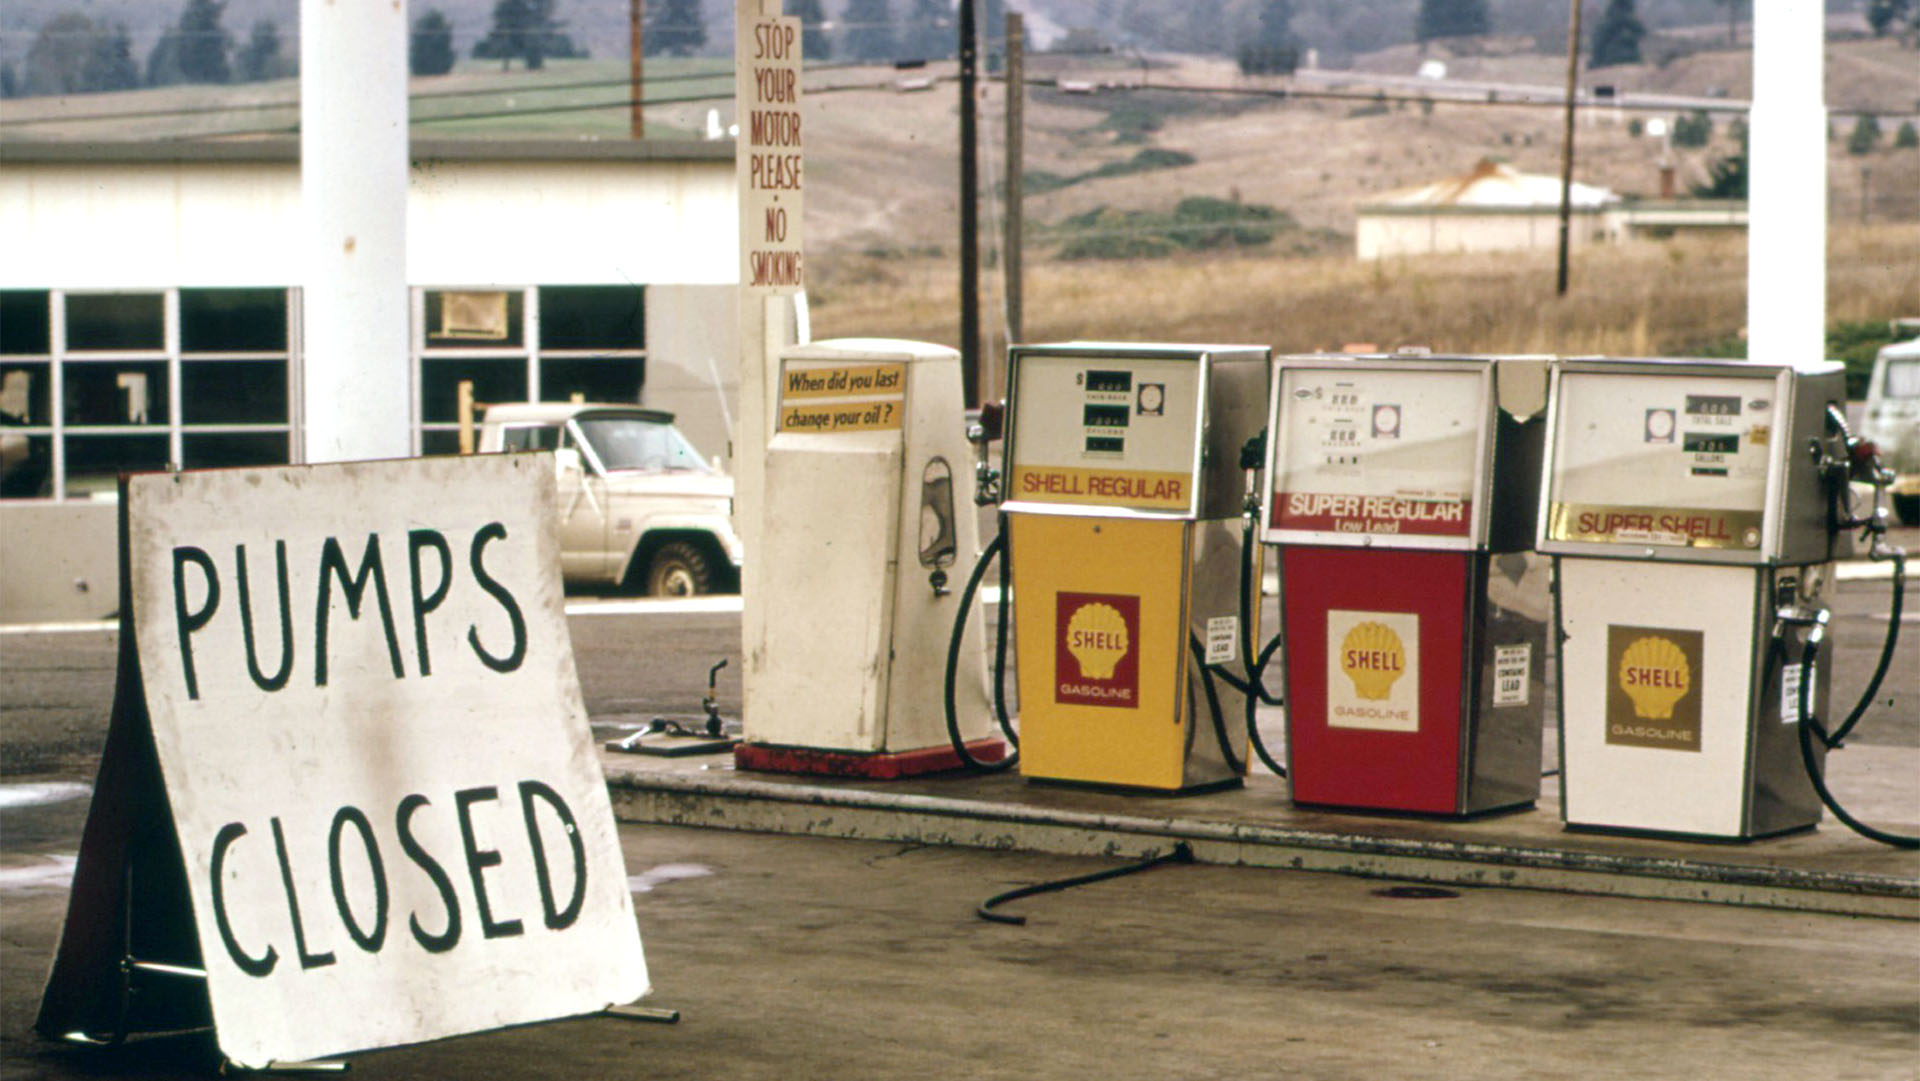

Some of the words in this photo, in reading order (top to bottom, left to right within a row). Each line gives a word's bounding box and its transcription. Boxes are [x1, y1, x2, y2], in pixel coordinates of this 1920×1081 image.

[755, 23, 794, 59] STOP
[754, 67, 796, 103] YOUR
[751, 110, 801, 147] MOTOR
[751, 154, 801, 190] PLEASE
[765, 207, 787, 242] NO
[750, 251, 801, 287] SMOKING
[789, 372, 825, 391] When
[827, 369, 848, 390] did
[849, 375, 873, 392] you
[875, 369, 899, 387] last
[785, 408, 830, 429] change
[833, 412, 861, 429] your
[1023, 472, 1083, 495] SHELL
[1088, 476, 1181, 499] REGULAR
[1289, 495, 1359, 517] SUPER
[1362, 498, 1463, 521] REGULAR
[1335, 519, 1362, 533] Low
[1366, 520, 1400, 534] Lead
[1578, 512, 1653, 534] SUPER
[1659, 515, 1731, 540] SHELL
[173, 522, 526, 700] PUMPS
[1073, 631, 1123, 650] SHELL
[1347, 650, 1400, 671] SHELL
[1502, 680, 1520, 691] LEAD
[1627, 667, 1684, 689] SHELL
[1060, 684, 1131, 699] GASOLINE
[1334, 705, 1409, 721] GASOLINE
[1611, 722, 1693, 742] GASOLINE
[210, 780, 586, 977] CLOSED
